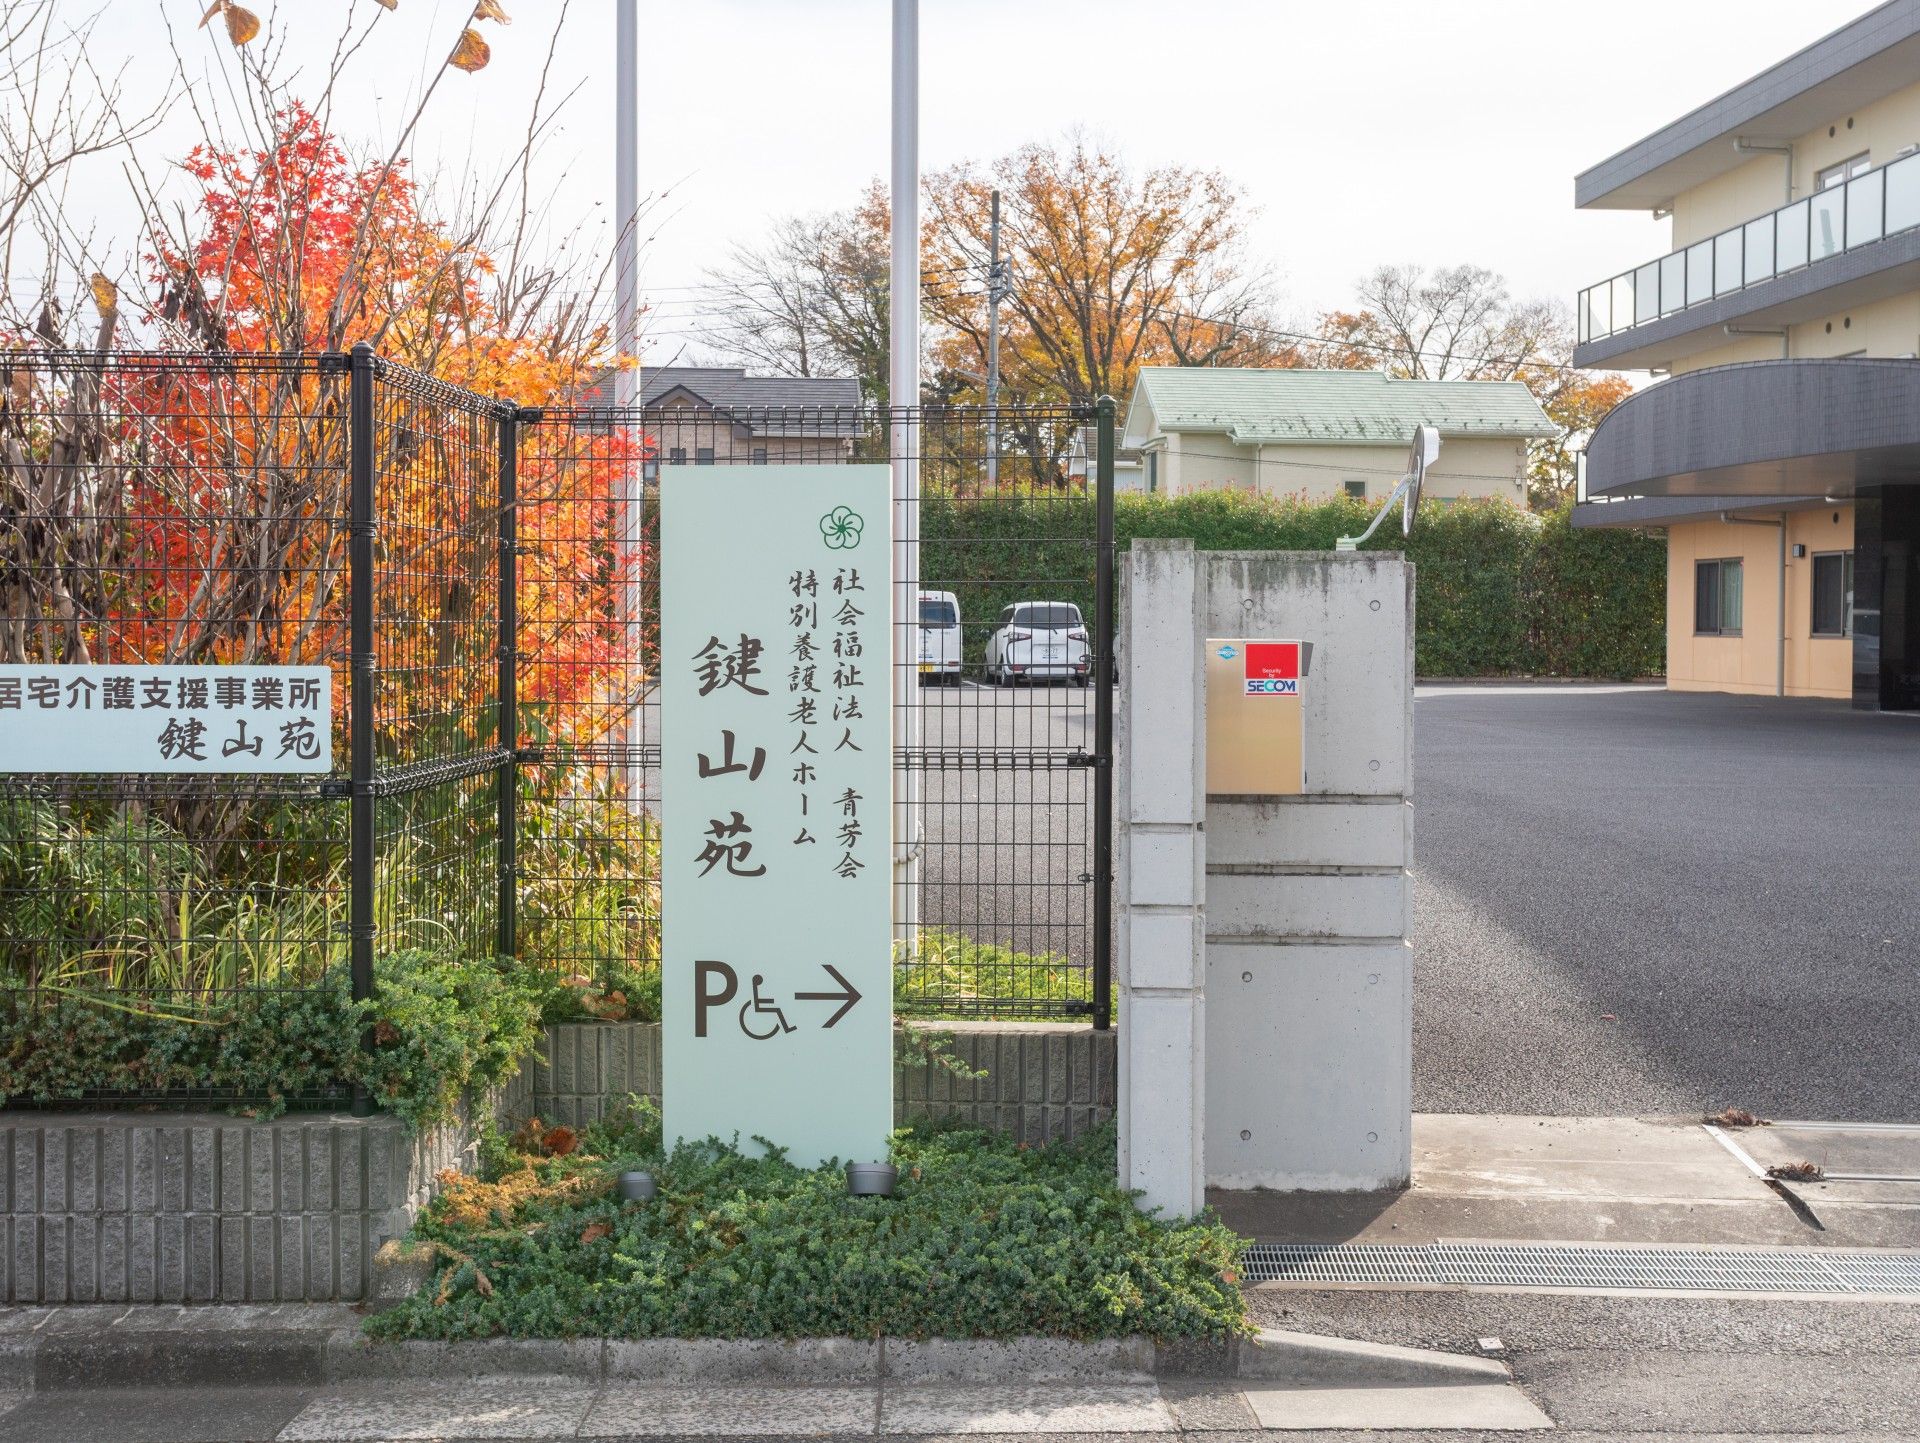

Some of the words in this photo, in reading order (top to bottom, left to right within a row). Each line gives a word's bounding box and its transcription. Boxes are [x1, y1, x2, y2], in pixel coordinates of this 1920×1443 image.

[832, 567, 865, 752] 社会福祉法人
[1247, 680, 1296, 692] SECOM
[158, 716, 321, 761] 鍵山苑
[787, 569, 822, 845] 特別養護老人ホーム
[691, 633, 770, 879] 鍵山苑
[832, 787, 866, 879] 青芳会
[694, 960, 739, 1038] P
